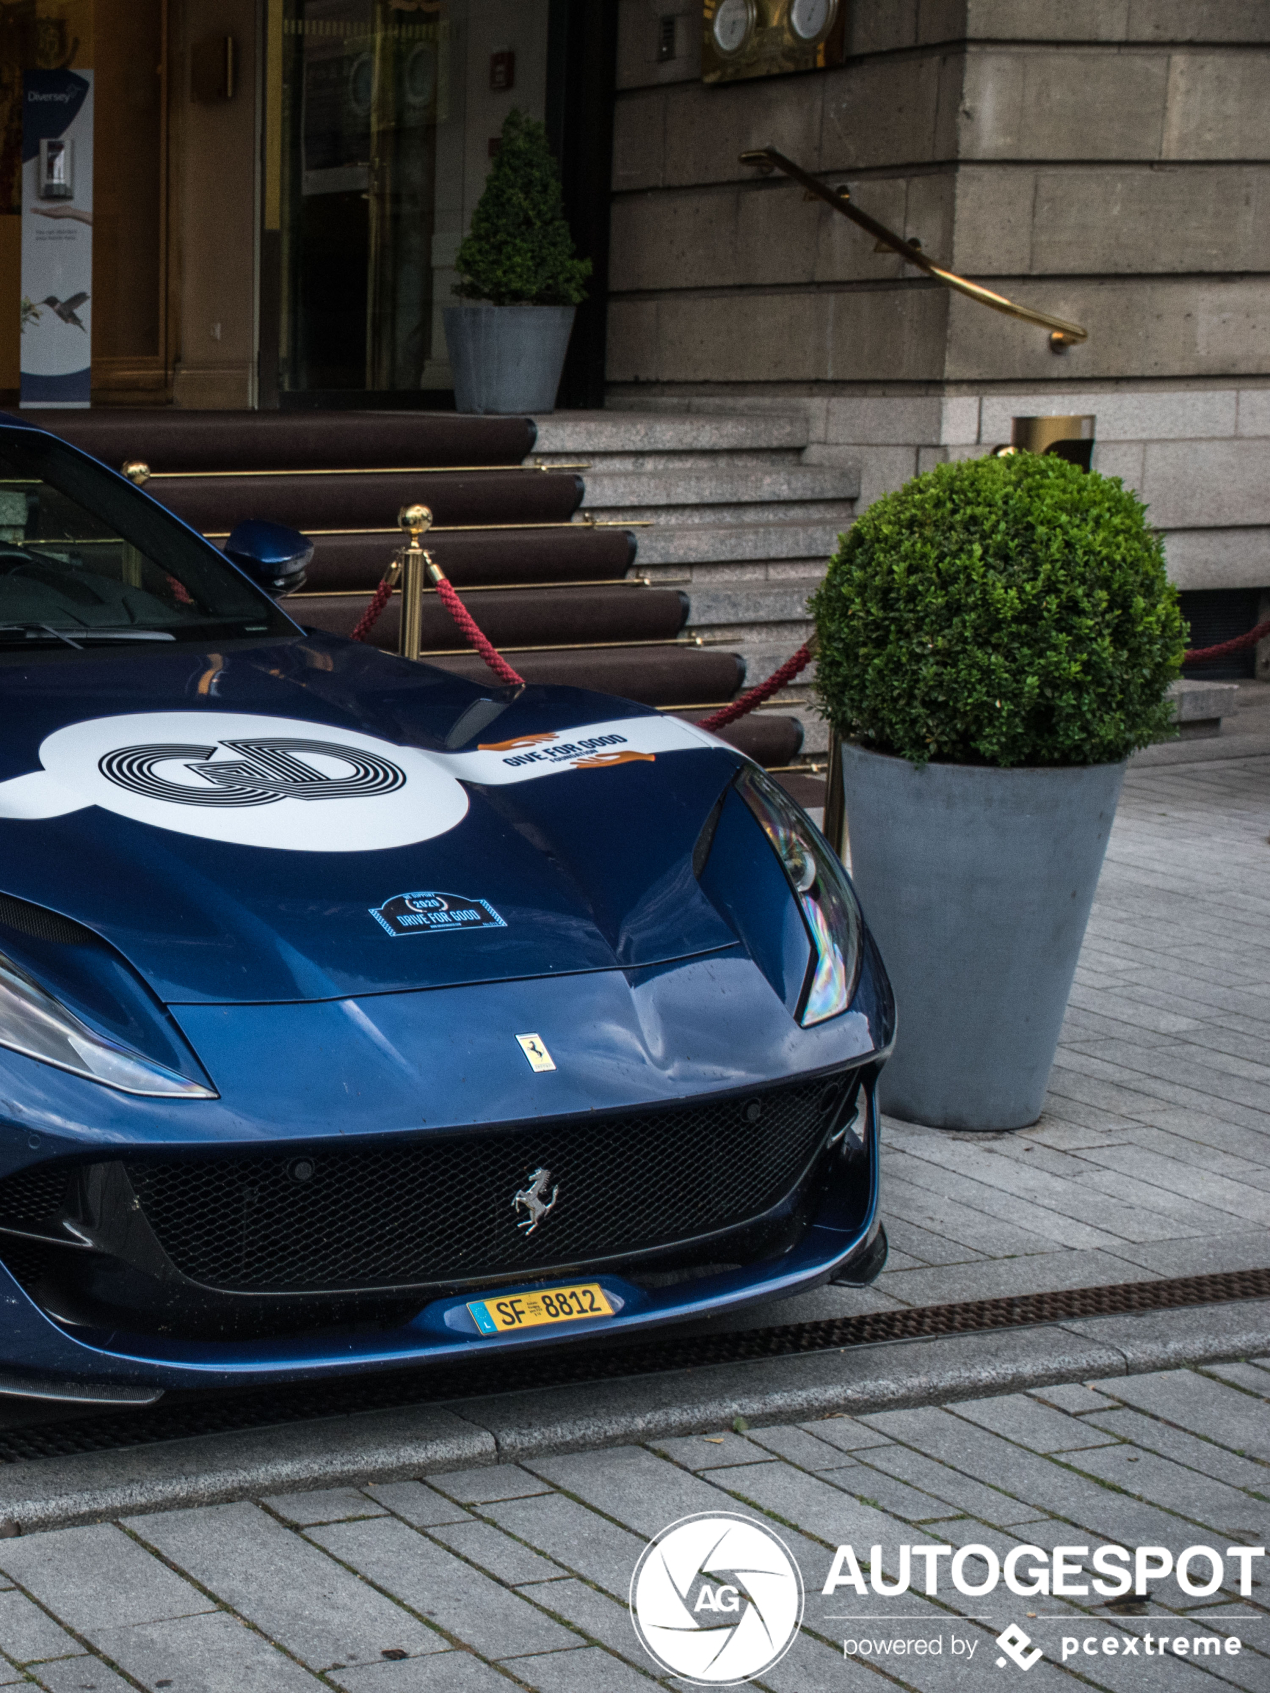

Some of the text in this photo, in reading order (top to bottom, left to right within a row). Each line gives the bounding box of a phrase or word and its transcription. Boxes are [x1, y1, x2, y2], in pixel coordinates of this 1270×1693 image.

[28, 90, 70, 104] Diversey
[502, 734, 628, 767] GIVE FOR GOOD
[549, 749, 599, 763] FOUNDATION
[412, 898, 441, 909] 2020
[396, 913, 431, 927] DRIVE
[427, 911, 453, 924] FOR
[449, 909, 481, 922] GOOD
[483, 1321, 491, 1329] L
[496, 1299, 526, 1326] SF
[541, 1289, 602, 1318] 8812
